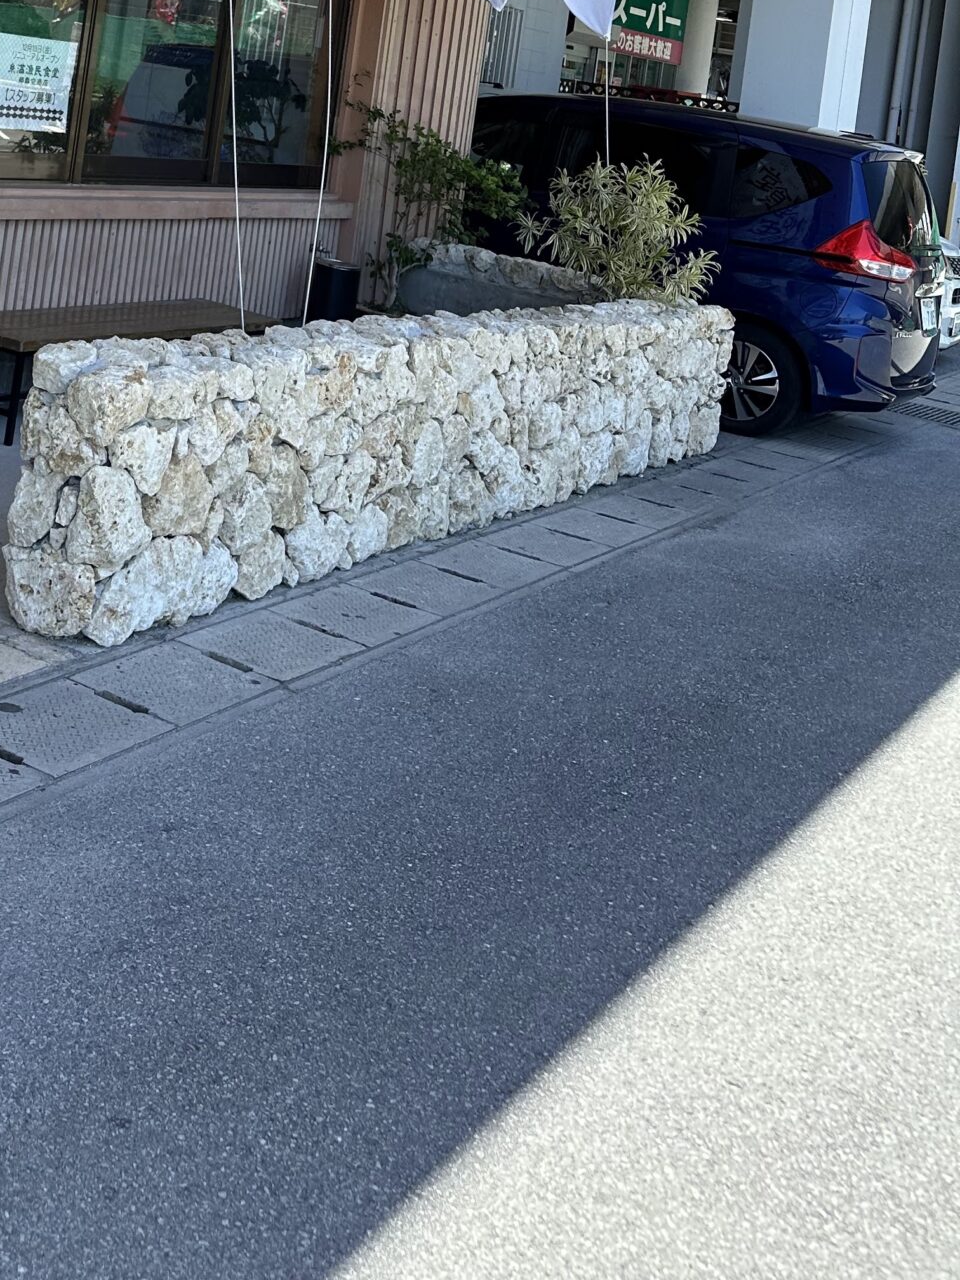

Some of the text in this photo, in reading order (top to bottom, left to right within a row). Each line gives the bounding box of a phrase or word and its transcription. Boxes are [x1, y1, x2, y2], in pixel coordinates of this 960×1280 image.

[612, 32, 672, 60] のお客様大歓迎
